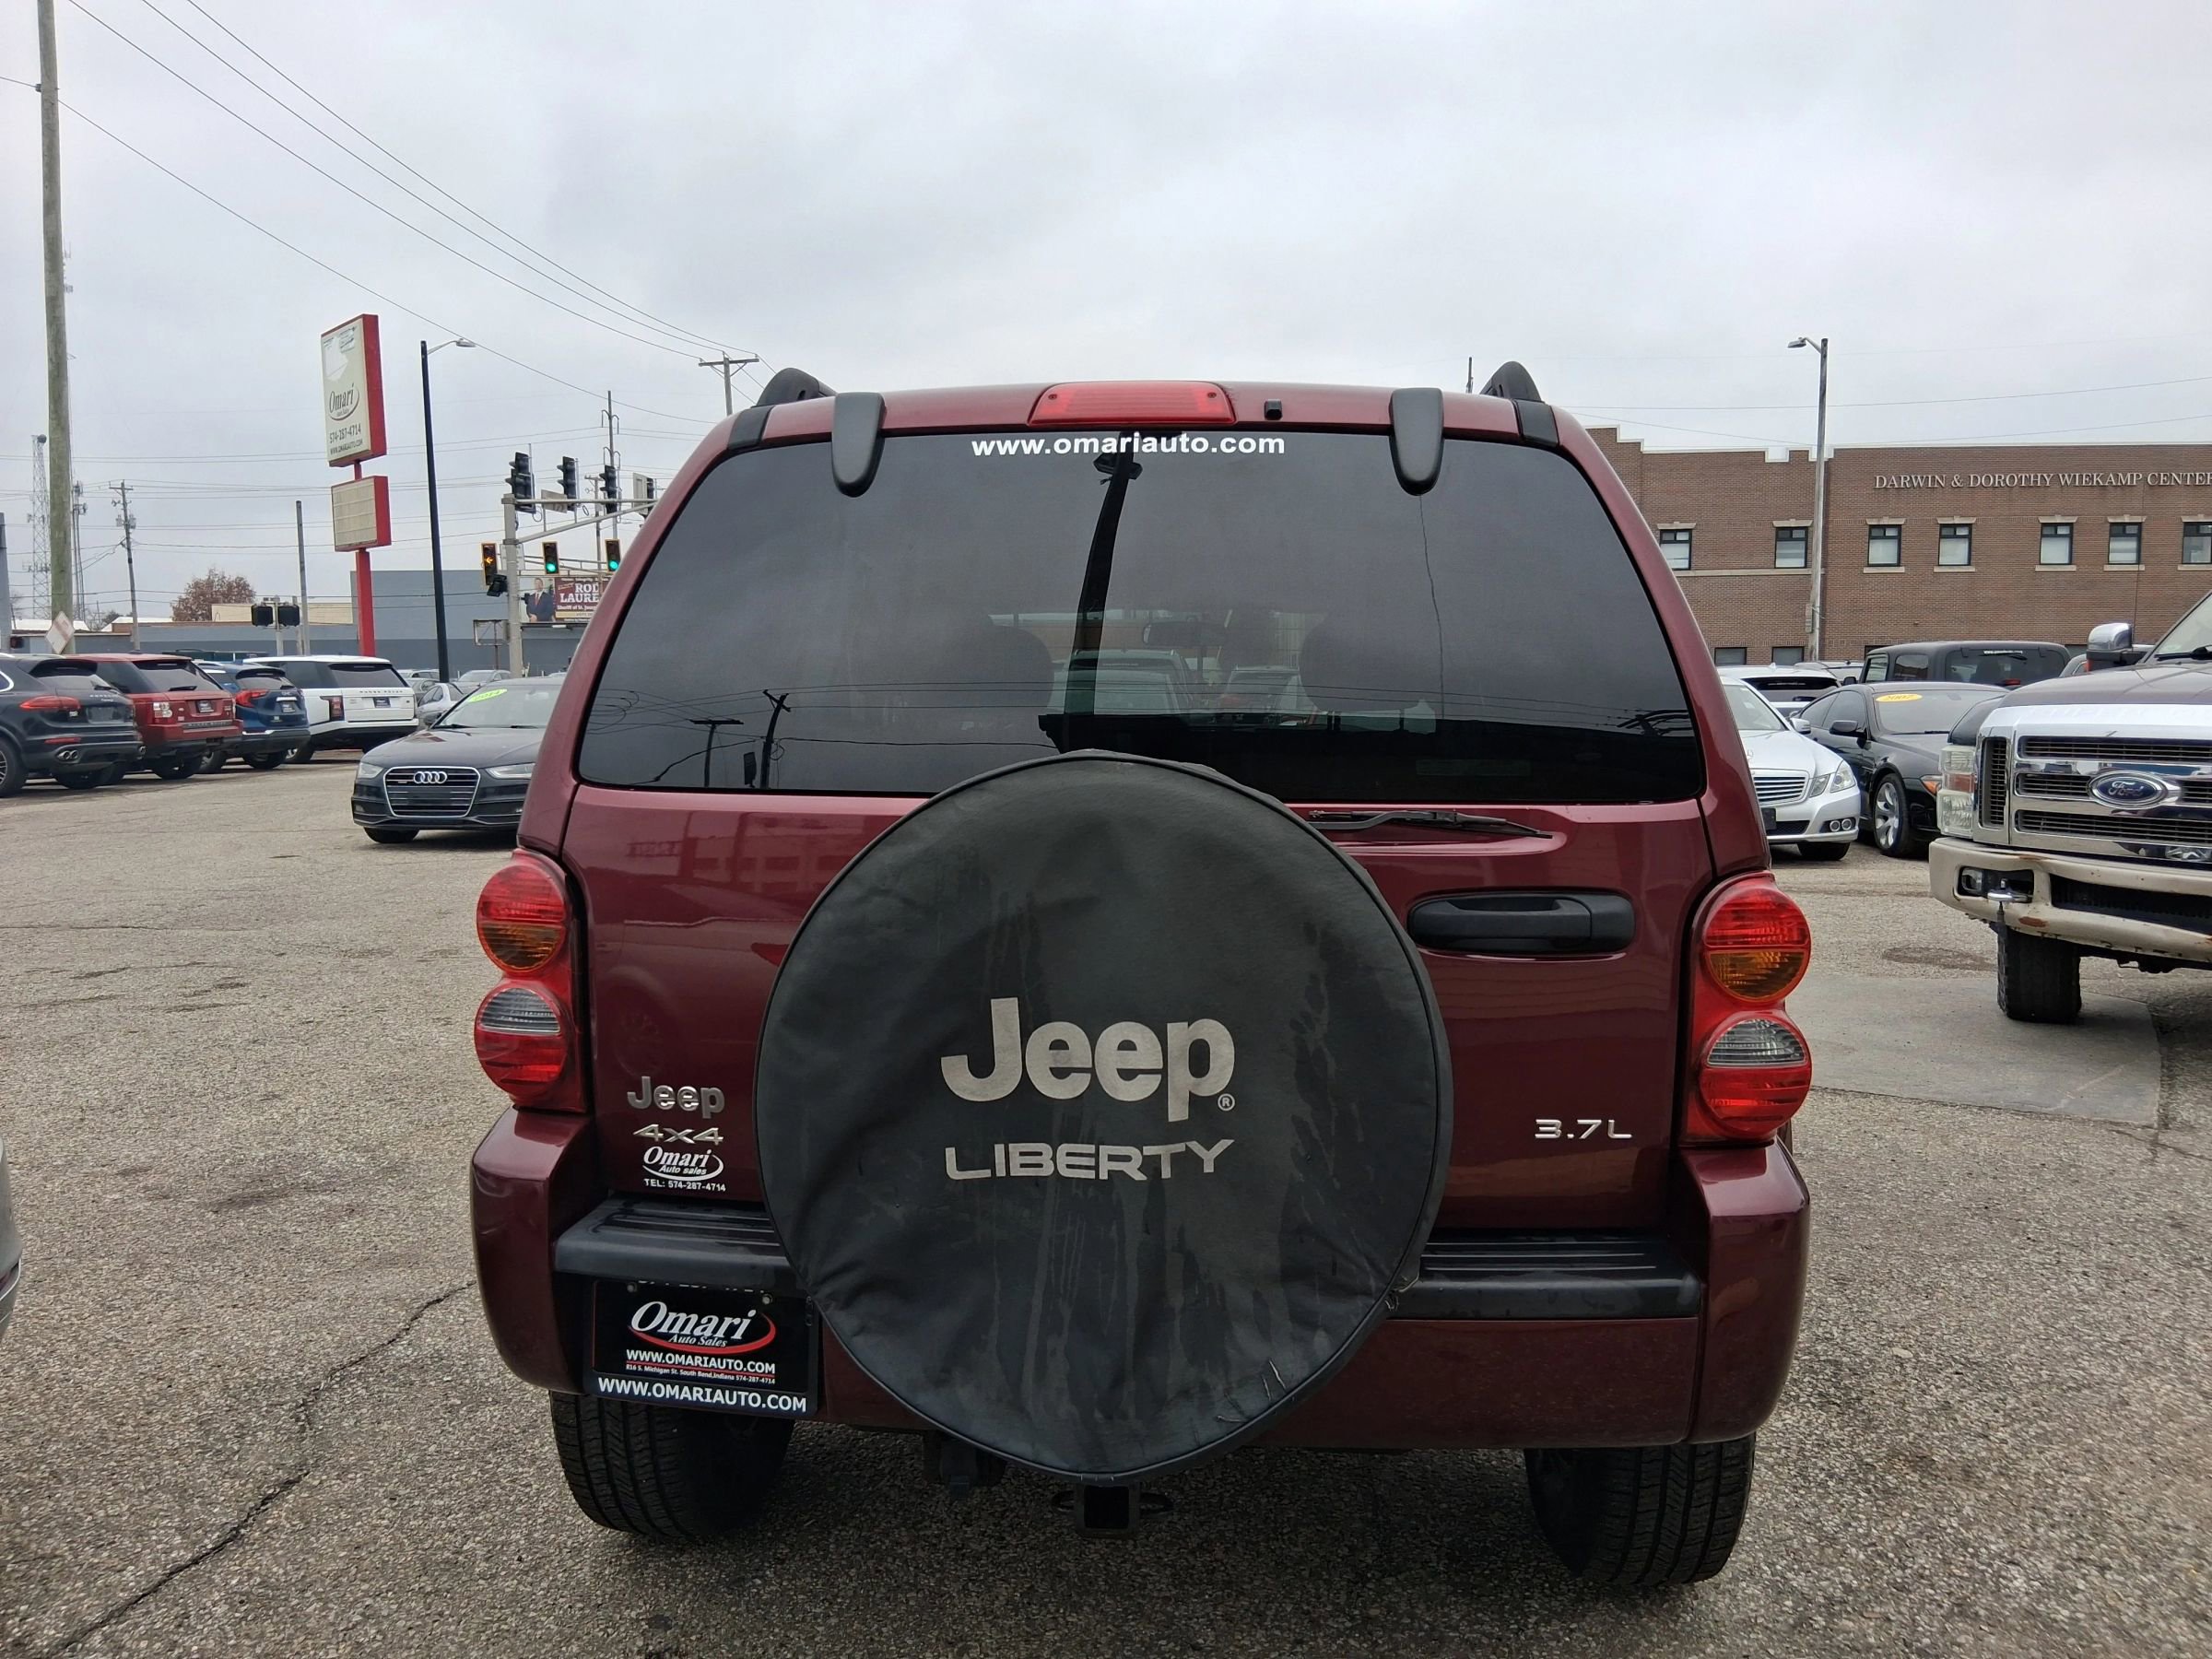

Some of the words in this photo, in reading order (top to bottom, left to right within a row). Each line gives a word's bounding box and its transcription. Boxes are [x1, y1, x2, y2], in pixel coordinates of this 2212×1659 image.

[329, 382, 354, 413] Omari
[971, 432, 1285, 455] www.omariauto.com
[1875, 475, 1946, 488] DARWIN
[1951, 474, 1963, 488] &
[1970, 472, 2053, 488] DOROTHY
[2058, 472, 2143, 486] WIEKAMP
[627, 1076, 725, 1119] Jeep
[1535, 1119, 1632, 1139] 3.7L
[643, 1146, 712, 1168] Omari
[945, 1139, 1235, 1181] LIBERTY
[659, 1165, 681, 1174] Auto
[644, 1179, 665, 1187] TEL:
[668, 1180, 726, 1192] 574-287-4714
[630, 1300, 757, 1340] Omari
[667, 1333, 697, 1345] Auto
[697, 1335, 728, 1347] Sales
[626, 1349, 776, 1374] WWW.OMARIAUTO.COM
[644, 1366, 670, 1374] Michigan
[679, 1369, 697, 1377] South
[735, 1374, 776, 1384] 574-287-4714
[598, 1377, 806, 1412] WWW.OMARIAUTO.COM
